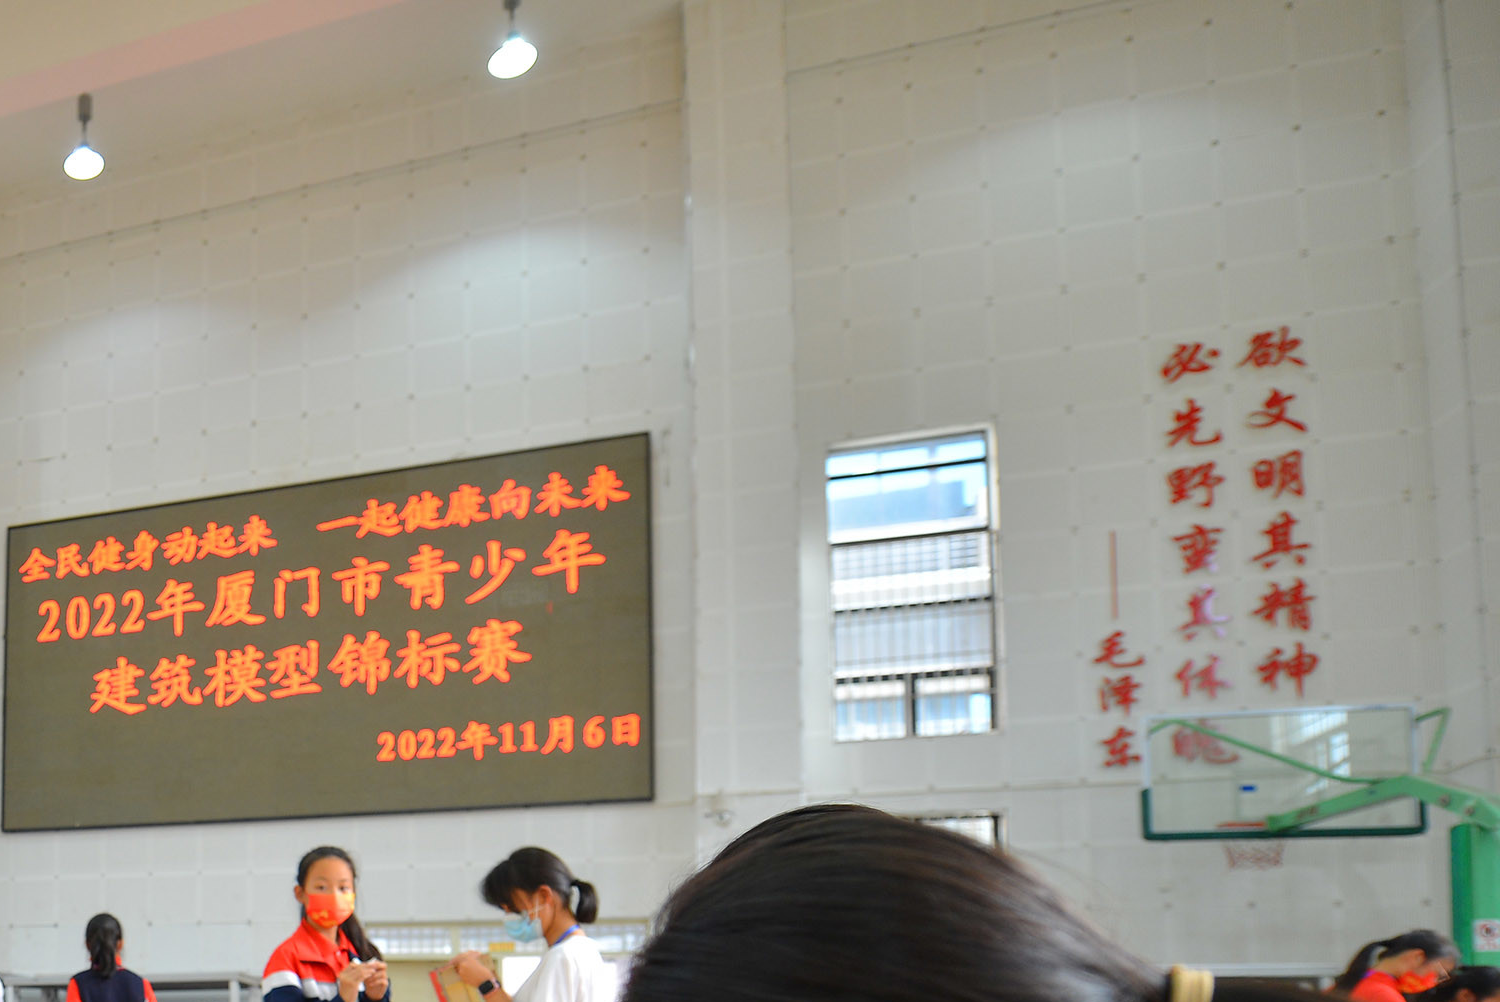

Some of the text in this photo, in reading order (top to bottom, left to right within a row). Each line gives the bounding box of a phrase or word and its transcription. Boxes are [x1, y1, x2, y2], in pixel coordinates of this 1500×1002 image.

[18, 465, 632, 583] 全民健身动起来 一起健康向未来
[1238, 326, 1320, 697] 欲文明其精神
[36, 529, 607, 643] 2022年厦门市青少年
[89, 618, 533, 716] 建筑模型锦标赛
[376, 713, 642, 762] 2022年11月6日
